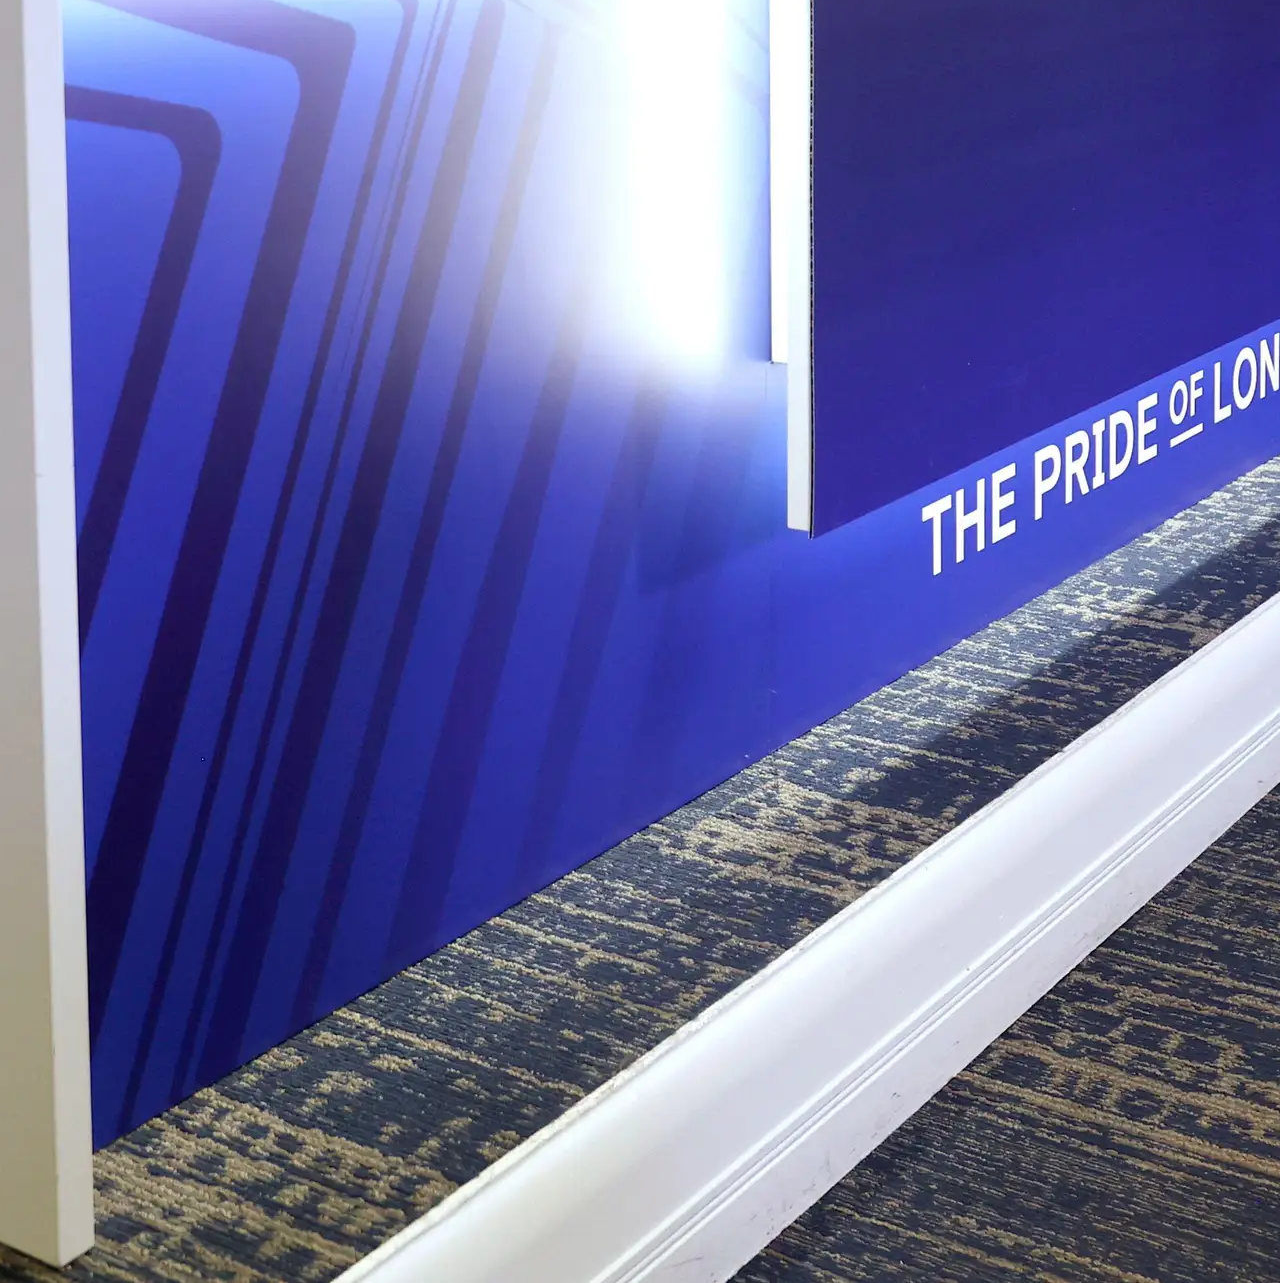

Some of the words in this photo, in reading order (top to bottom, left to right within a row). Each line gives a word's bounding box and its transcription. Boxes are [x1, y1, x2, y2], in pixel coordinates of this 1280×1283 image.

[921, 462, 1016, 576] THE
[1034, 392, 1158, 521] PRIDE
[1169, 369, 1204, 425] OF
